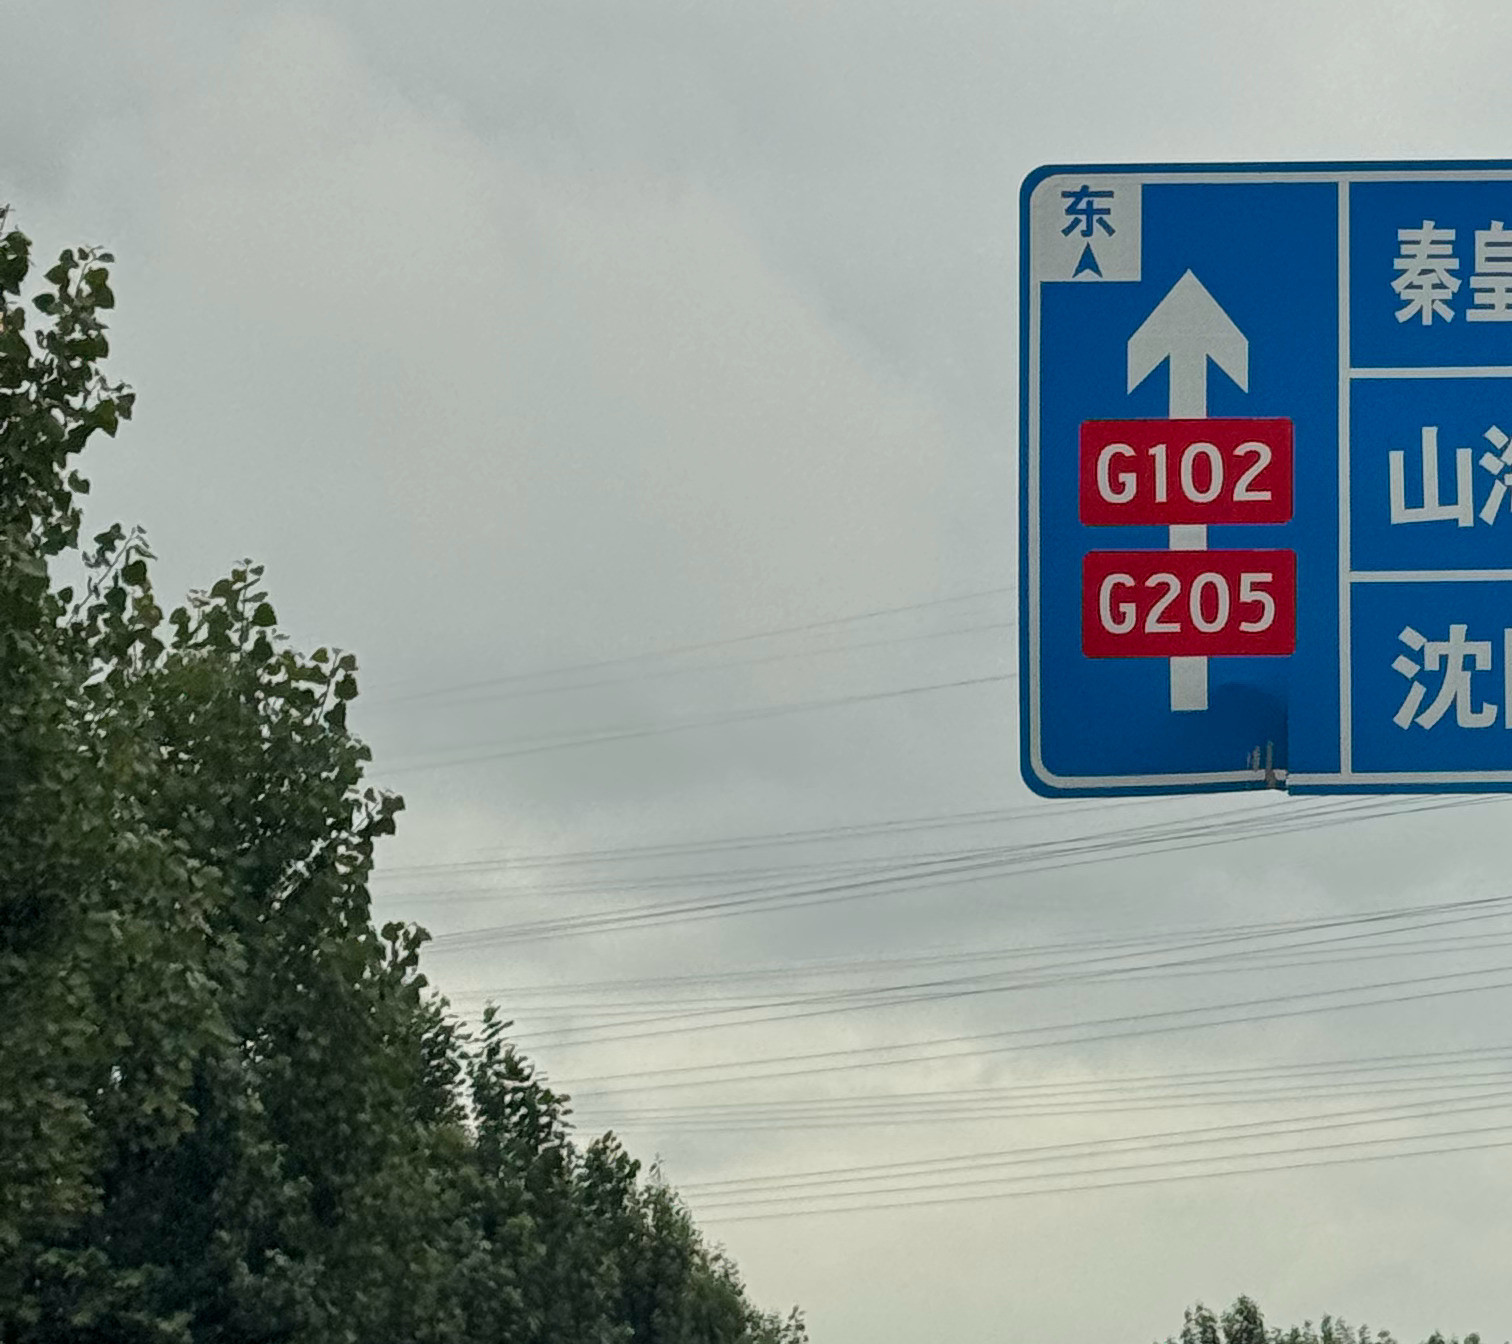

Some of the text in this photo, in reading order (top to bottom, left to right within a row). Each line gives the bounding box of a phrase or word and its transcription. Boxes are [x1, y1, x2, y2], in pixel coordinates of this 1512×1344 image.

[1061, 185, 1115, 238] 东
[1098, 442, 1271, 503] G102
[1100, 573, 1274, 633] G205
